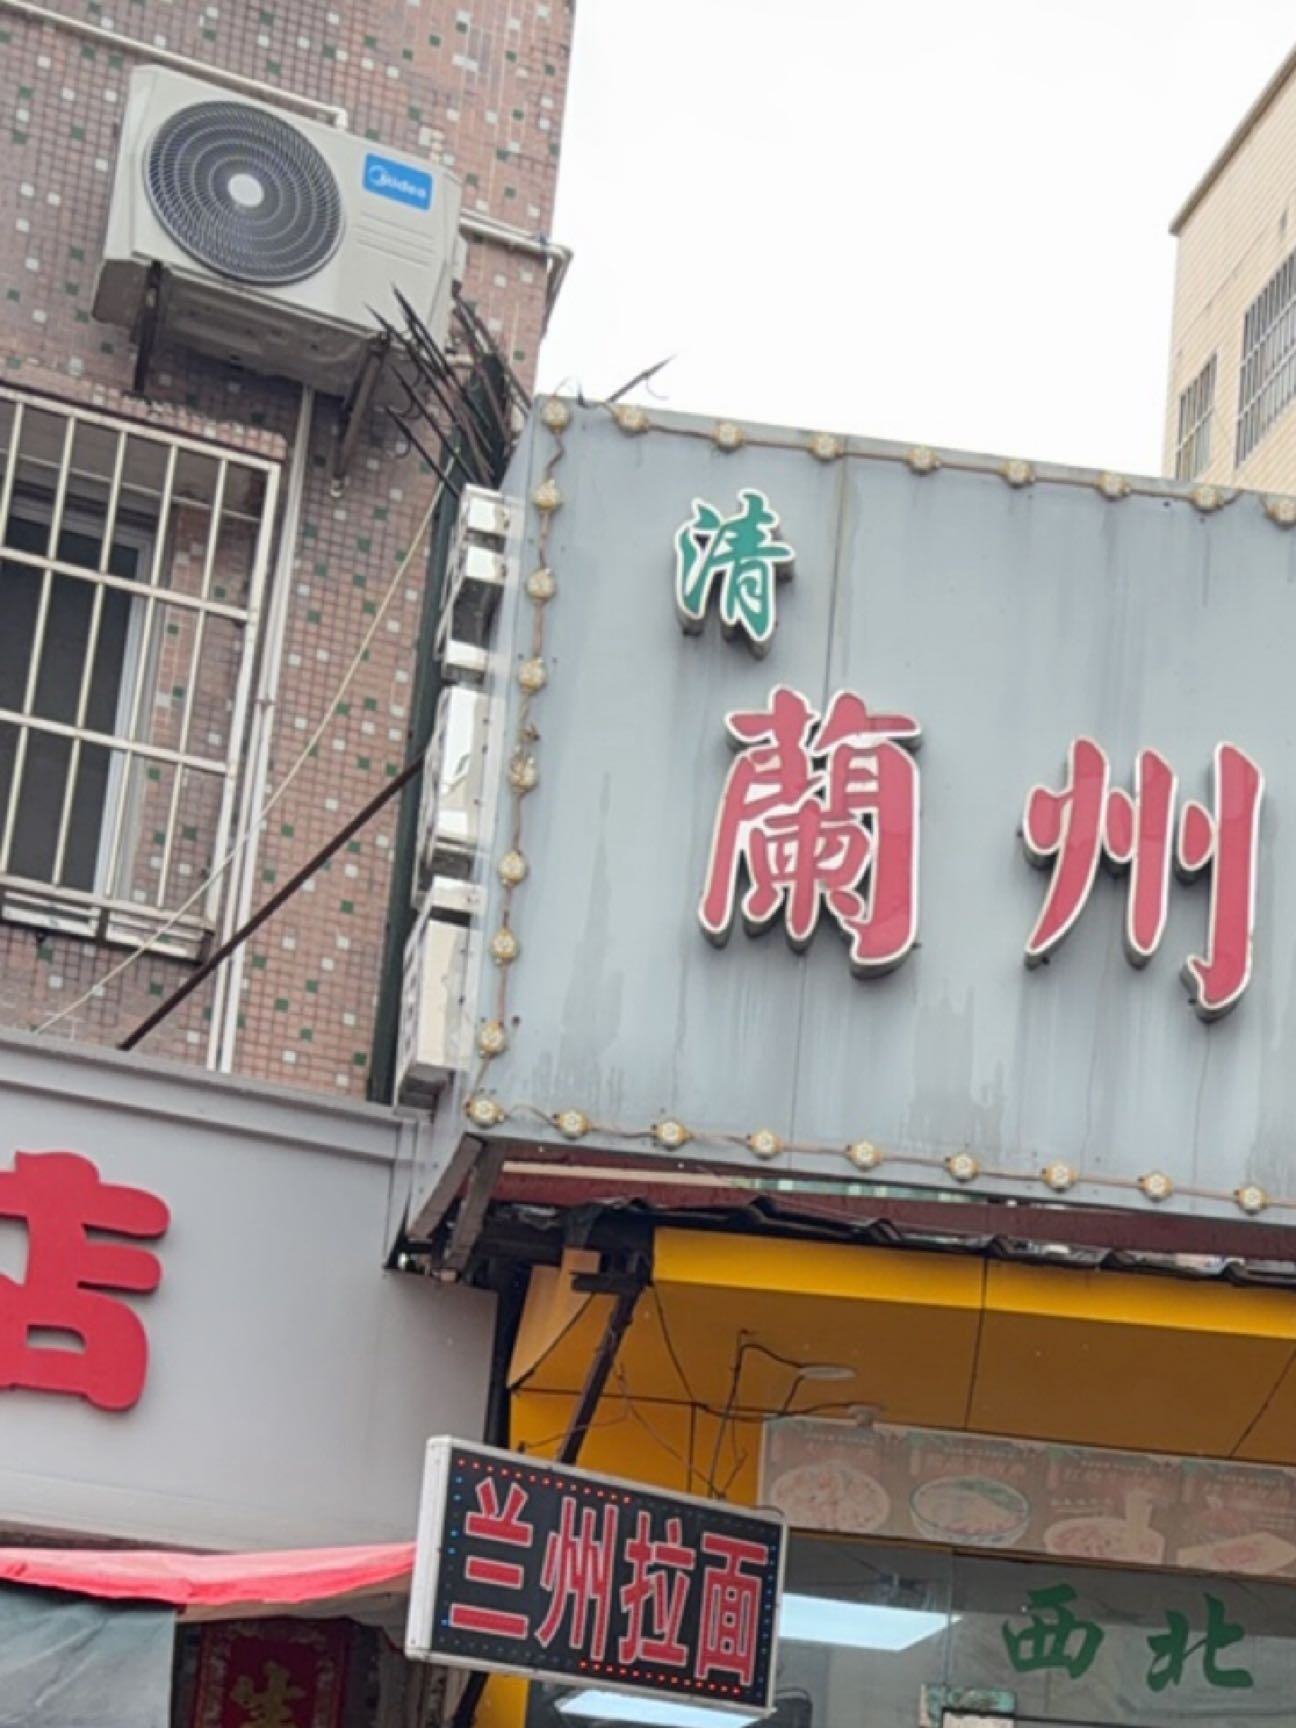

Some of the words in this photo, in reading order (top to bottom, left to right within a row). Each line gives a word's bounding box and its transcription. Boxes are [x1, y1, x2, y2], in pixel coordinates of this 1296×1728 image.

[676, 490, 793, 642] 清
[0, 1150, 171, 1412] 店
[450, 1477, 769, 1687] 兰州拉面
